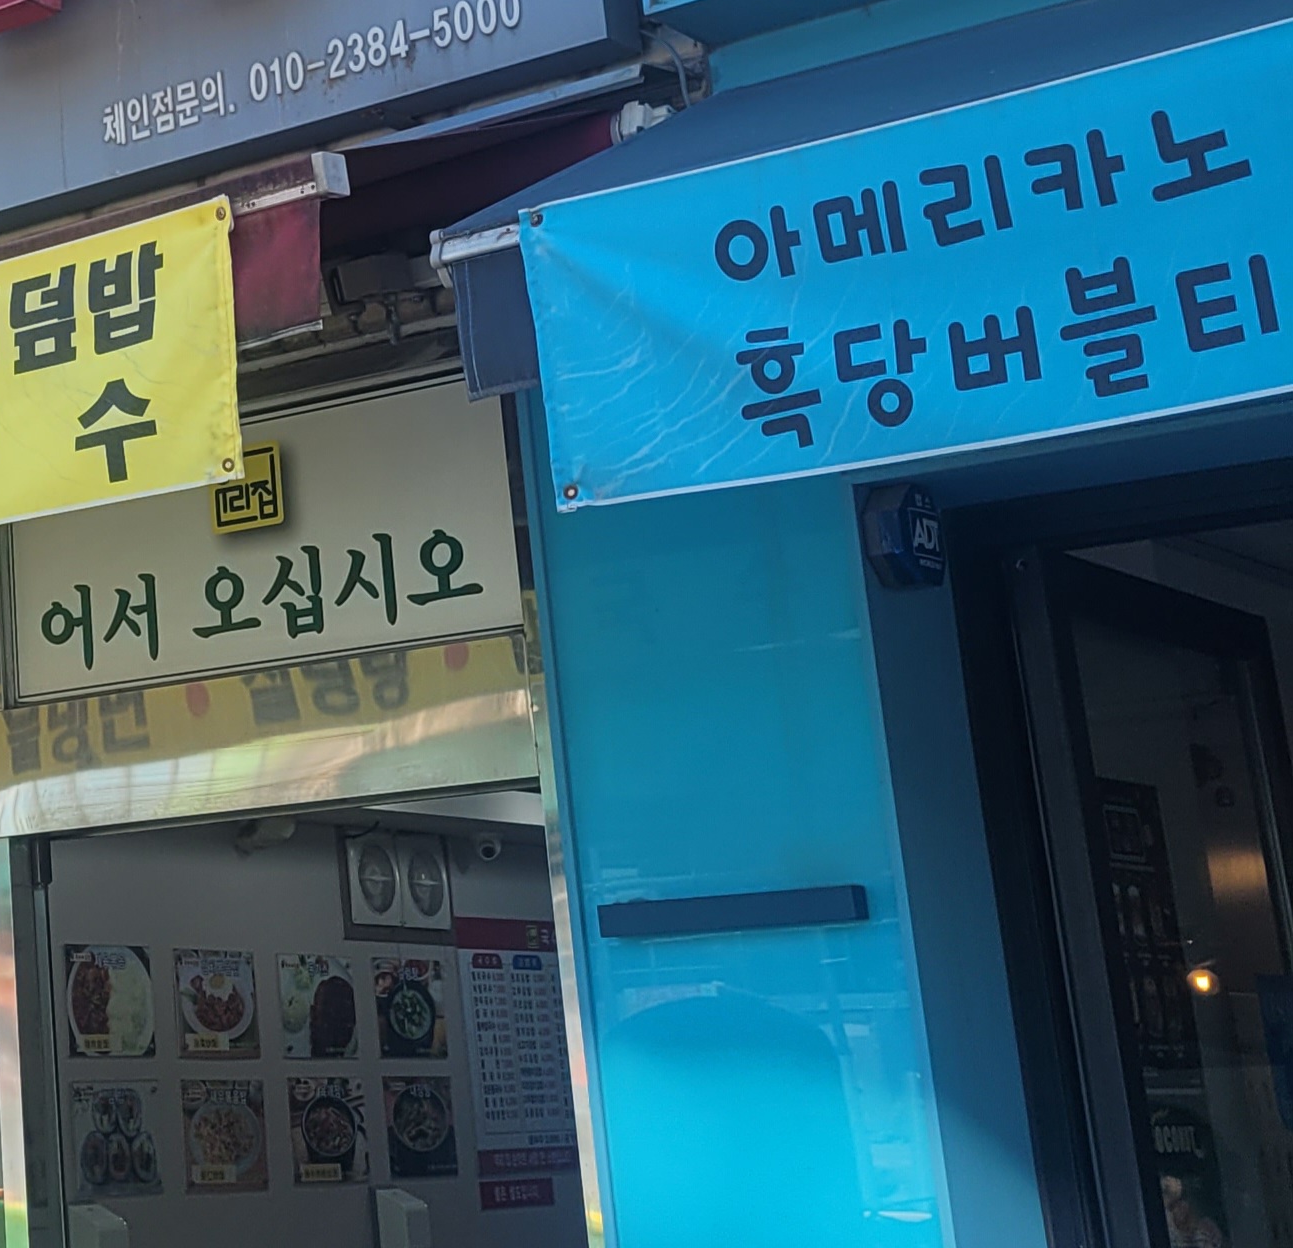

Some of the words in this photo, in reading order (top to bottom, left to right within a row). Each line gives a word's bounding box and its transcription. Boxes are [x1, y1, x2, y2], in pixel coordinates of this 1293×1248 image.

[713, 110, 1253, 281] 아메리카노
[735, 253, 1279, 448] 흑당버블티
[40, 572, 160, 671] 어서
[191, 528, 484, 640] 오십시오
[913, 517, 940, 552] ADT
